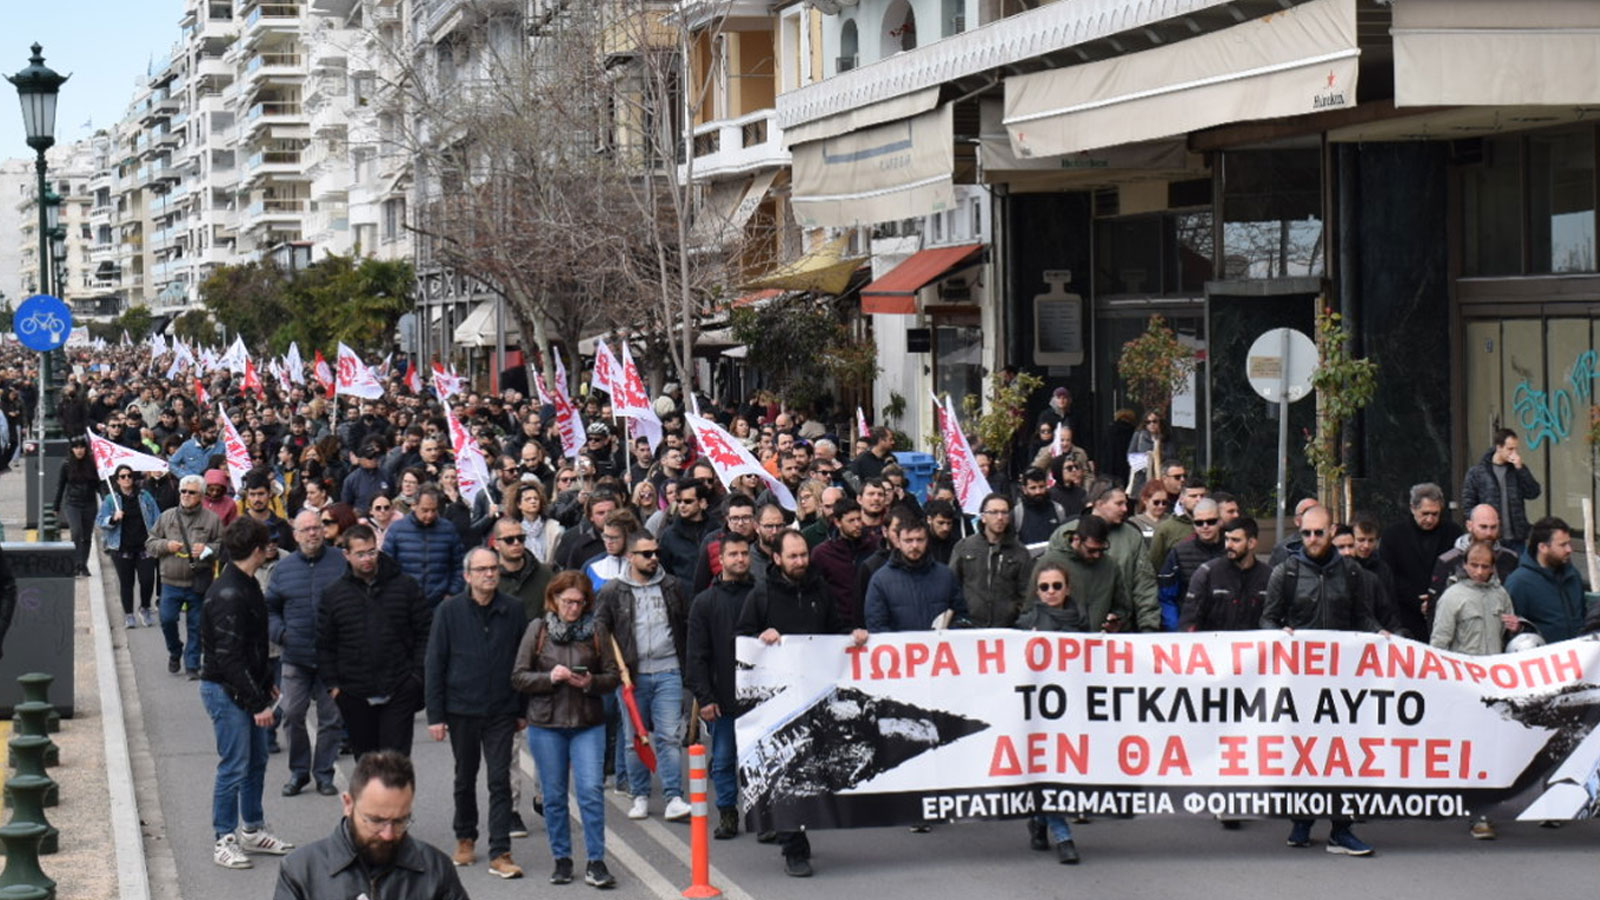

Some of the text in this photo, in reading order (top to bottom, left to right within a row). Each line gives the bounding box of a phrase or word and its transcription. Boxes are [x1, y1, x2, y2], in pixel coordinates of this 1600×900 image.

[846, 636, 1584, 689] ΤΩΡΑ Η ΟΡΓΗ ΝΑ ΓΙΝΕΙ ΑΝΑΤΡΟΠΗ
[1015, 684, 1426, 726] ΤΟ ΕΓΚΛΗΜΑ ΑΥΤΟ
[989, 732, 1489, 780] ΔΕΝ ΘΑ ΞΕΧΑΣΤΕΙ.
[922, 788, 1472, 820] ΕΡΓΑΤΙΚΑ ΣΩΜΑΤΕΙΑ ΦΟΙΤΗΤΙΚΟΙ ΣΥΛΛΟΓΟΙ.
